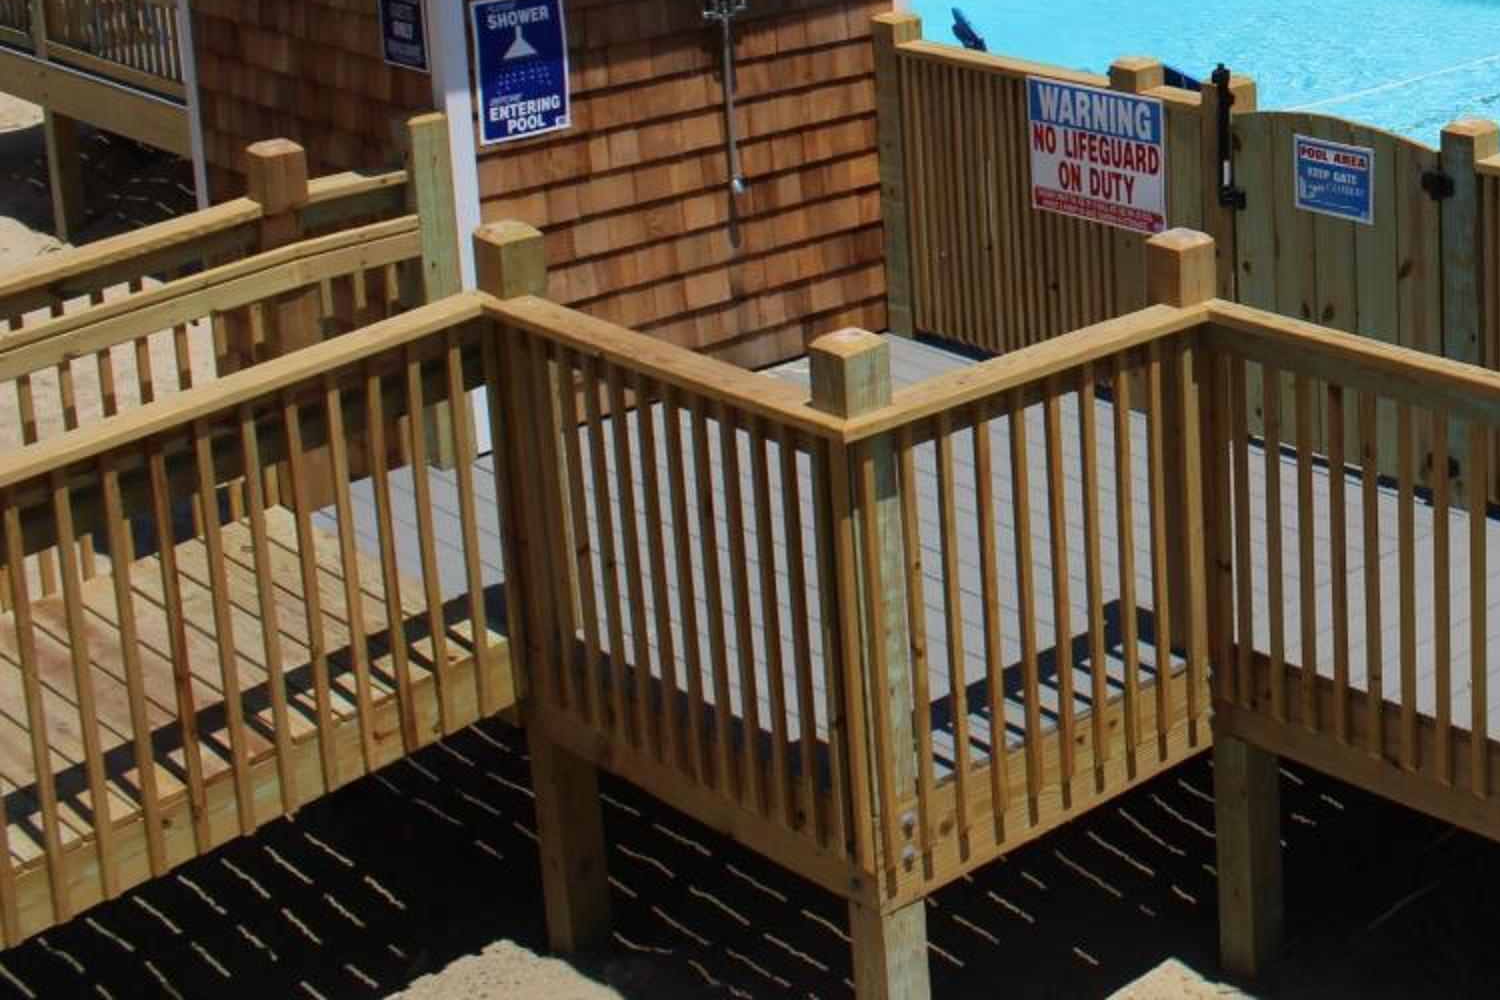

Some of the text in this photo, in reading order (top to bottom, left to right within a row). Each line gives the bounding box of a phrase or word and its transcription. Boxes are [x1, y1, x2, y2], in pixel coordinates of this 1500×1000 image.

[486, 5, 550, 30] SHOWER
[489, 95, 561, 122] ENTERING
[1037, 83, 1152, 140] WARNING
[507, 117, 547, 134] POOL
[1033, 122, 1160, 175] NO LIFEGUARD
[1299, 144, 1367, 169] POOL AREA
[1058, 160, 1136, 205] ON DUTY
